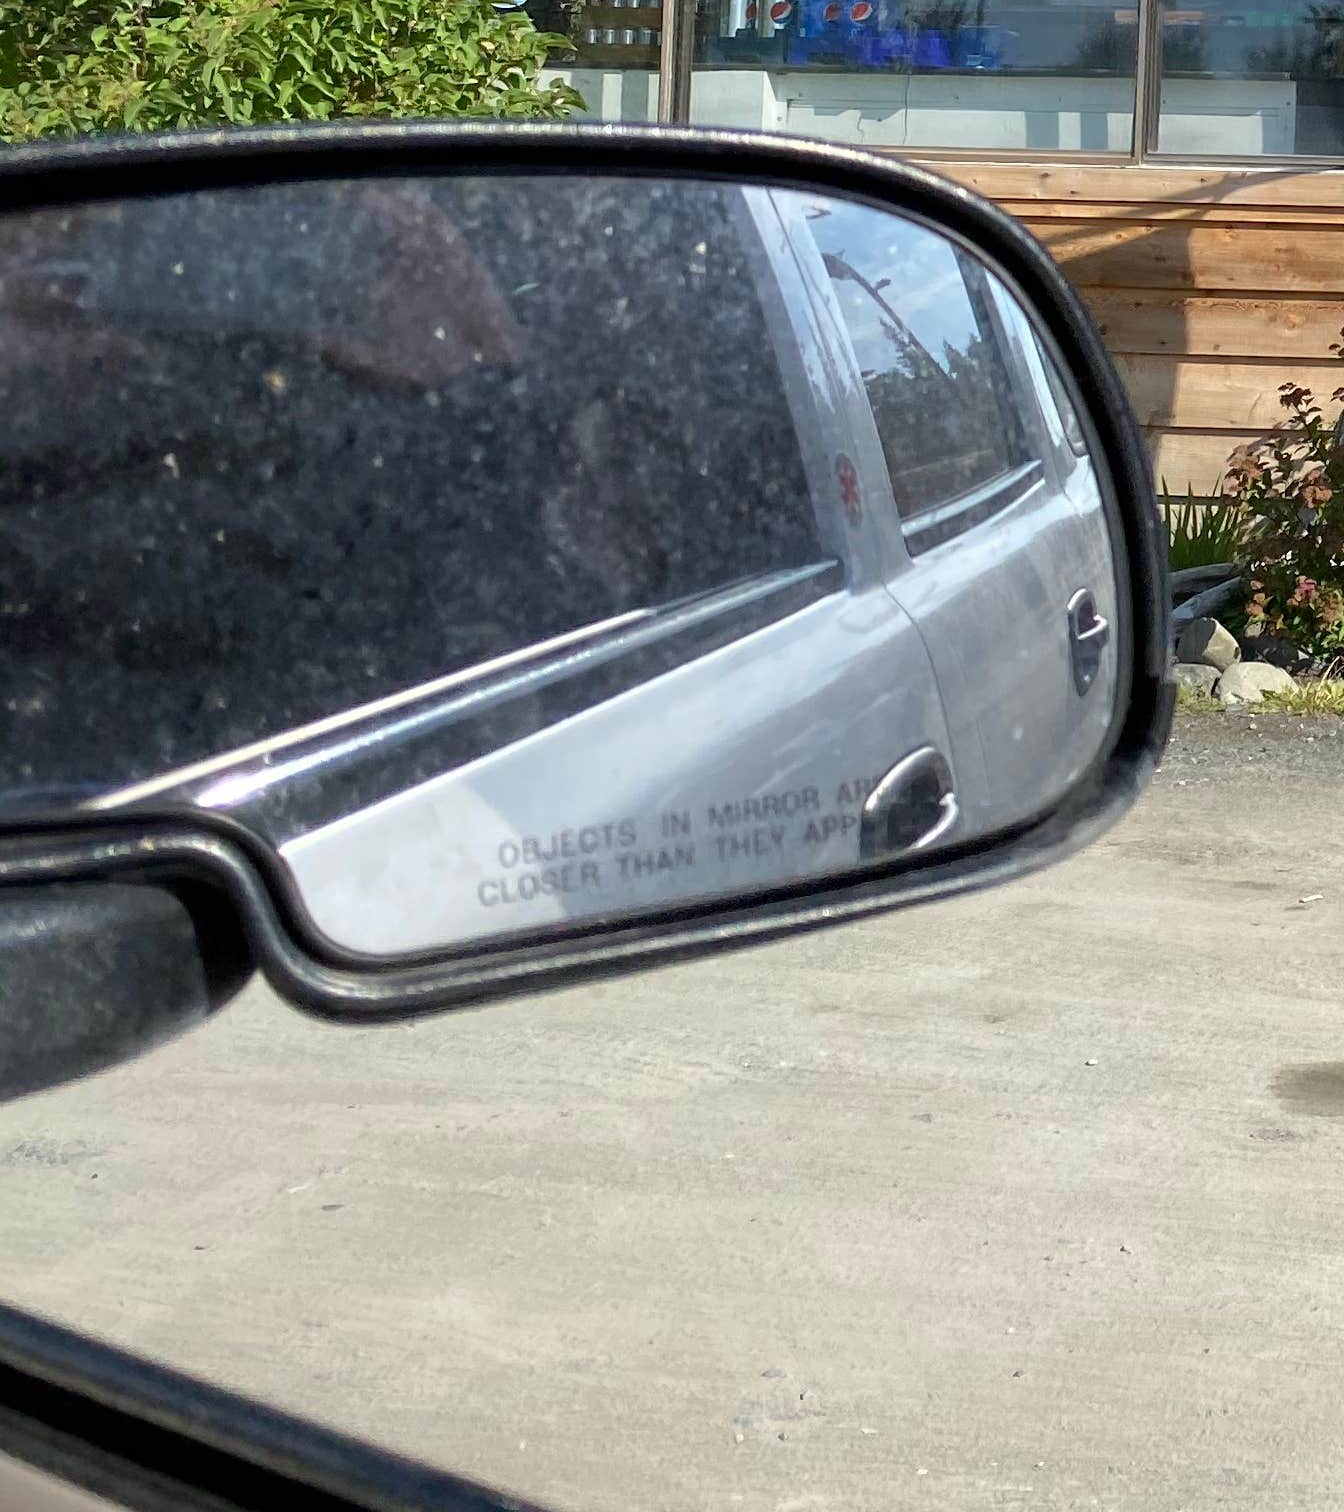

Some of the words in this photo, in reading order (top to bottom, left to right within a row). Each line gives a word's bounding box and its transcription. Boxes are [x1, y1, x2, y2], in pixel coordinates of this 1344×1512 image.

[477, 862, 599, 907] CLOSER
[616, 847, 694, 879] THAN
[716, 829, 788, 863] THEY
[499, 820, 637, 870] OBJECTS
[661, 809, 691, 838] IN
[708, 785, 820, 827] MIRROR
